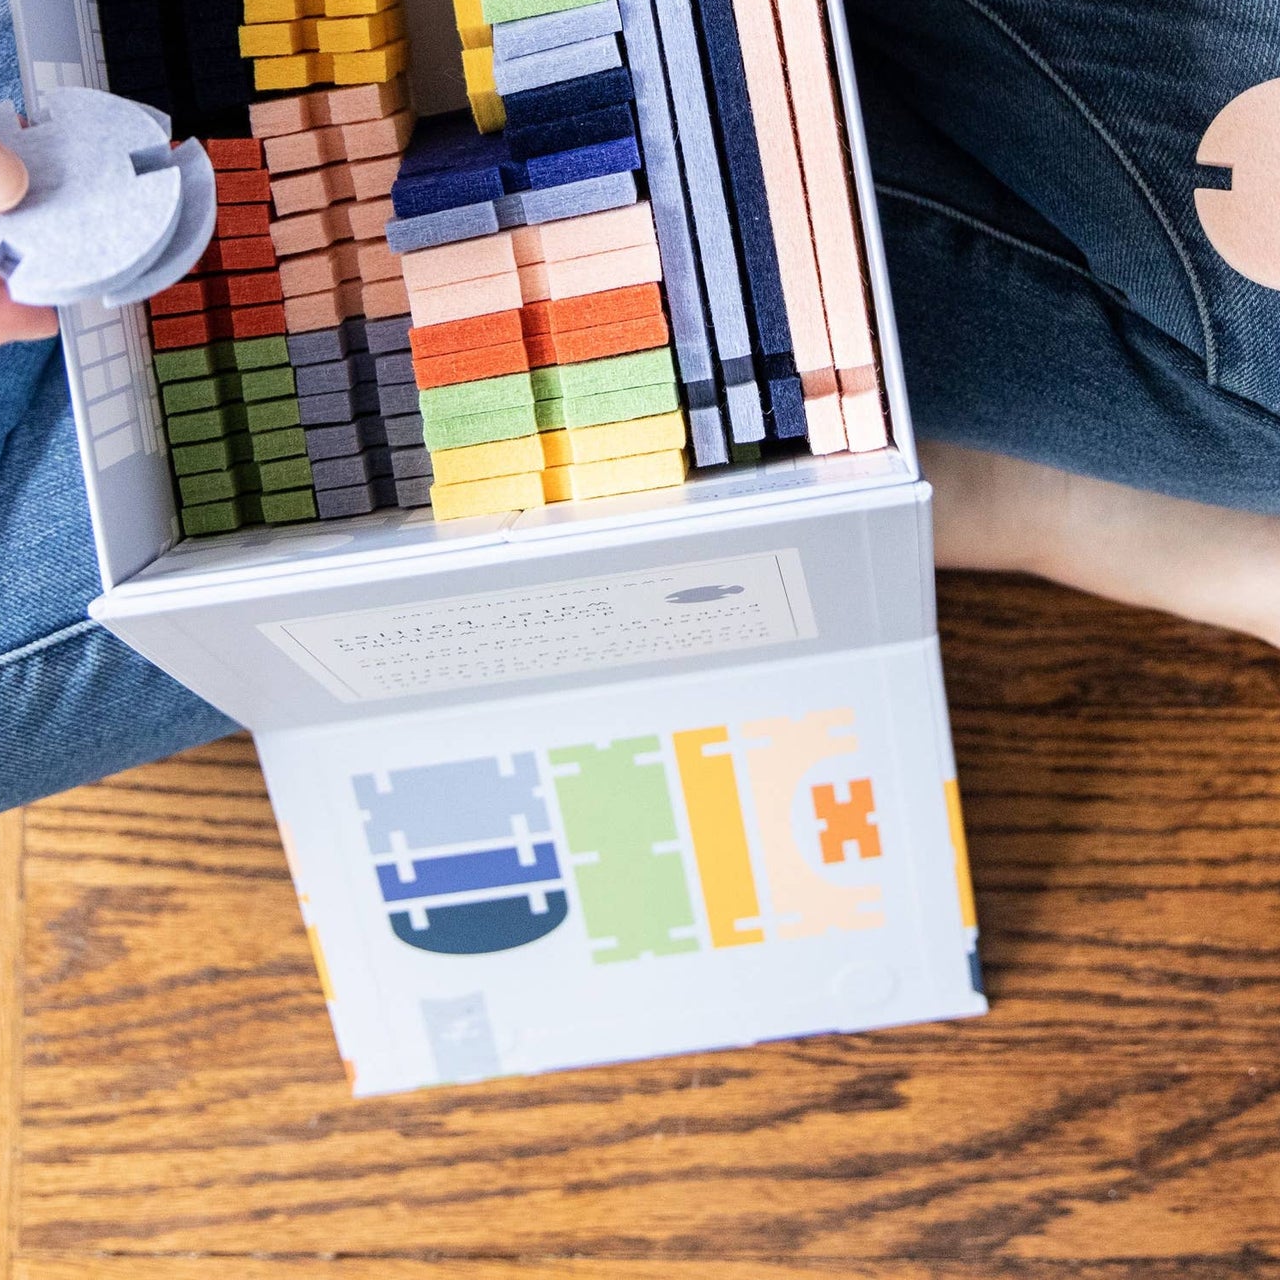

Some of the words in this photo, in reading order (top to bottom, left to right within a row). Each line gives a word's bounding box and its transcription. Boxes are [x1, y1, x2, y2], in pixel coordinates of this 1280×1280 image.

[388, 576, 676, 621] www.lowercasetoys.com
[496, 599, 610, 620] water
[541, 605, 613, 620] made
[660, 607, 762, 626] created
[329, 619, 473, 644] bottles
[466, 617, 529, 630] from
[334, 628, 454, 649] recycled
[339, 629, 478, 653] washable
[474, 633, 545, 647] made
